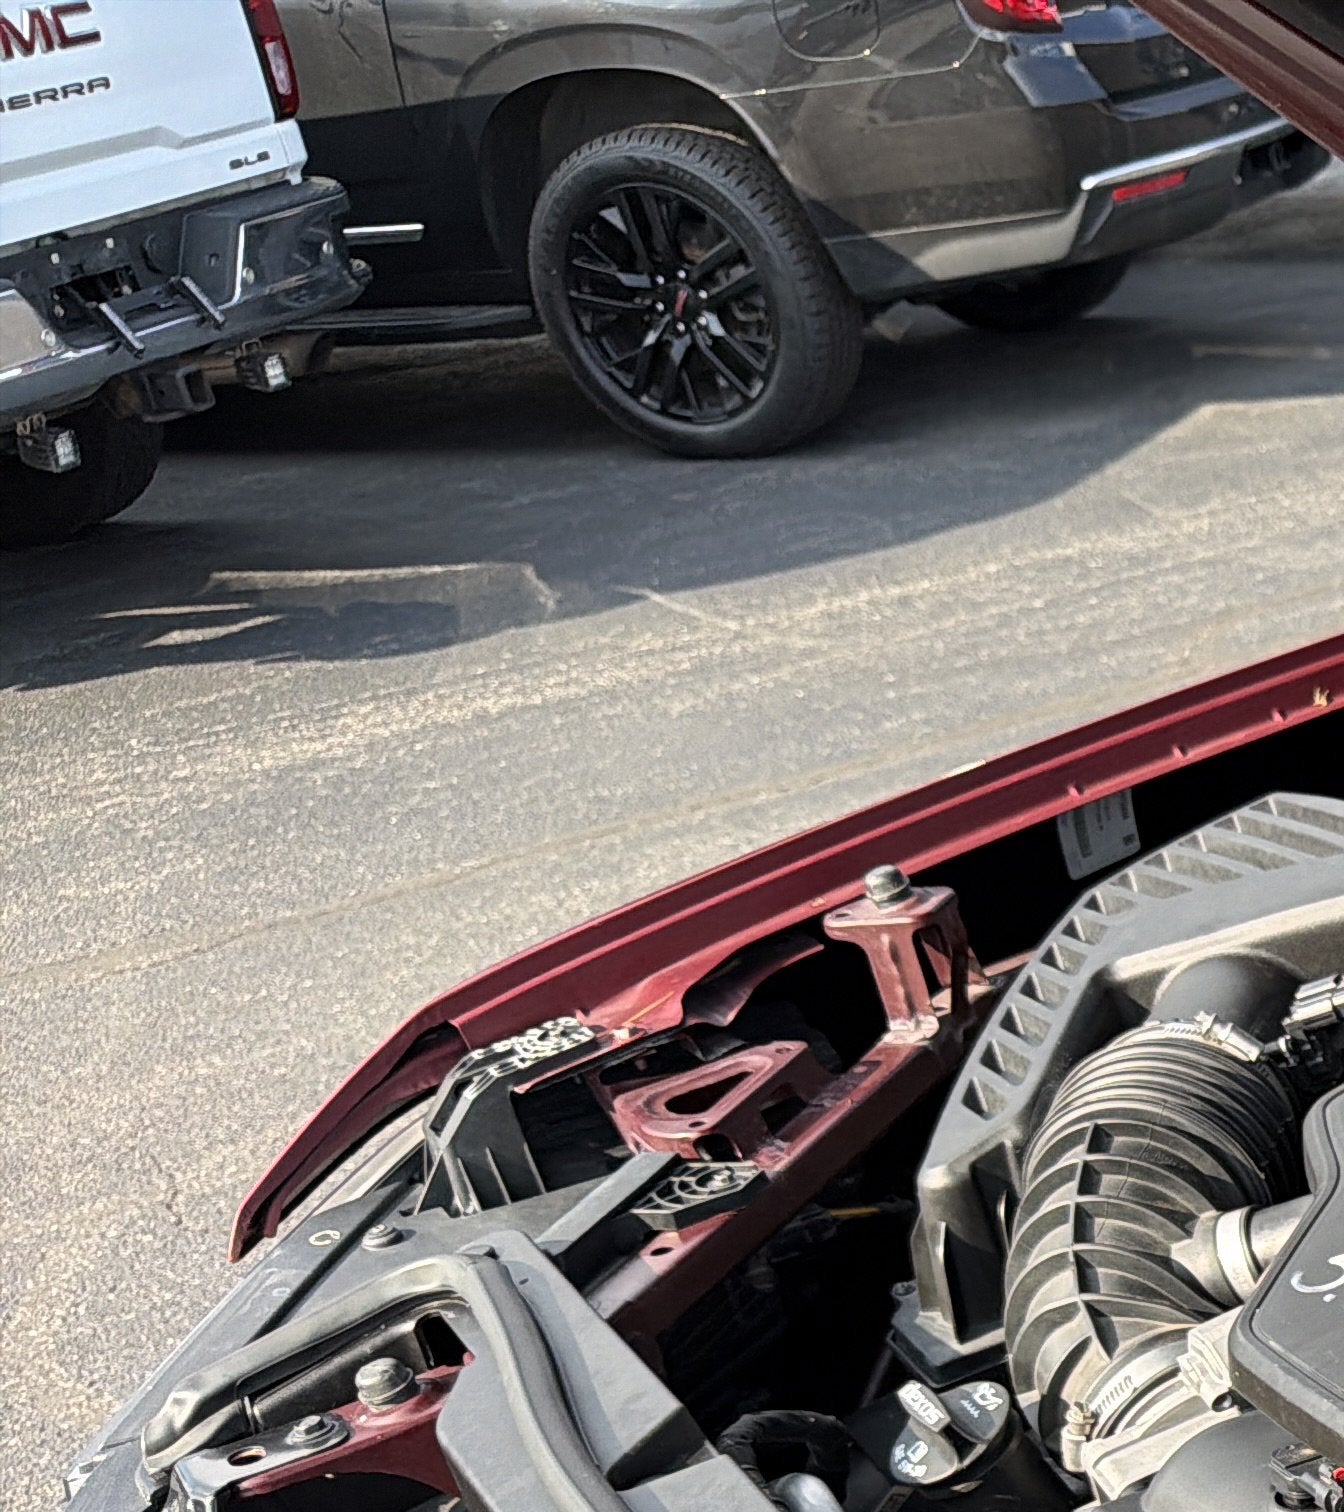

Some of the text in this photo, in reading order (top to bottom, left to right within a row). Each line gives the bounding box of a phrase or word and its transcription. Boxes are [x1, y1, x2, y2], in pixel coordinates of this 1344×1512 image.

[0, 2, 101, 60] MC
[0, 76, 111, 113] ERRA
[902, 1381, 945, 1425] dexos
